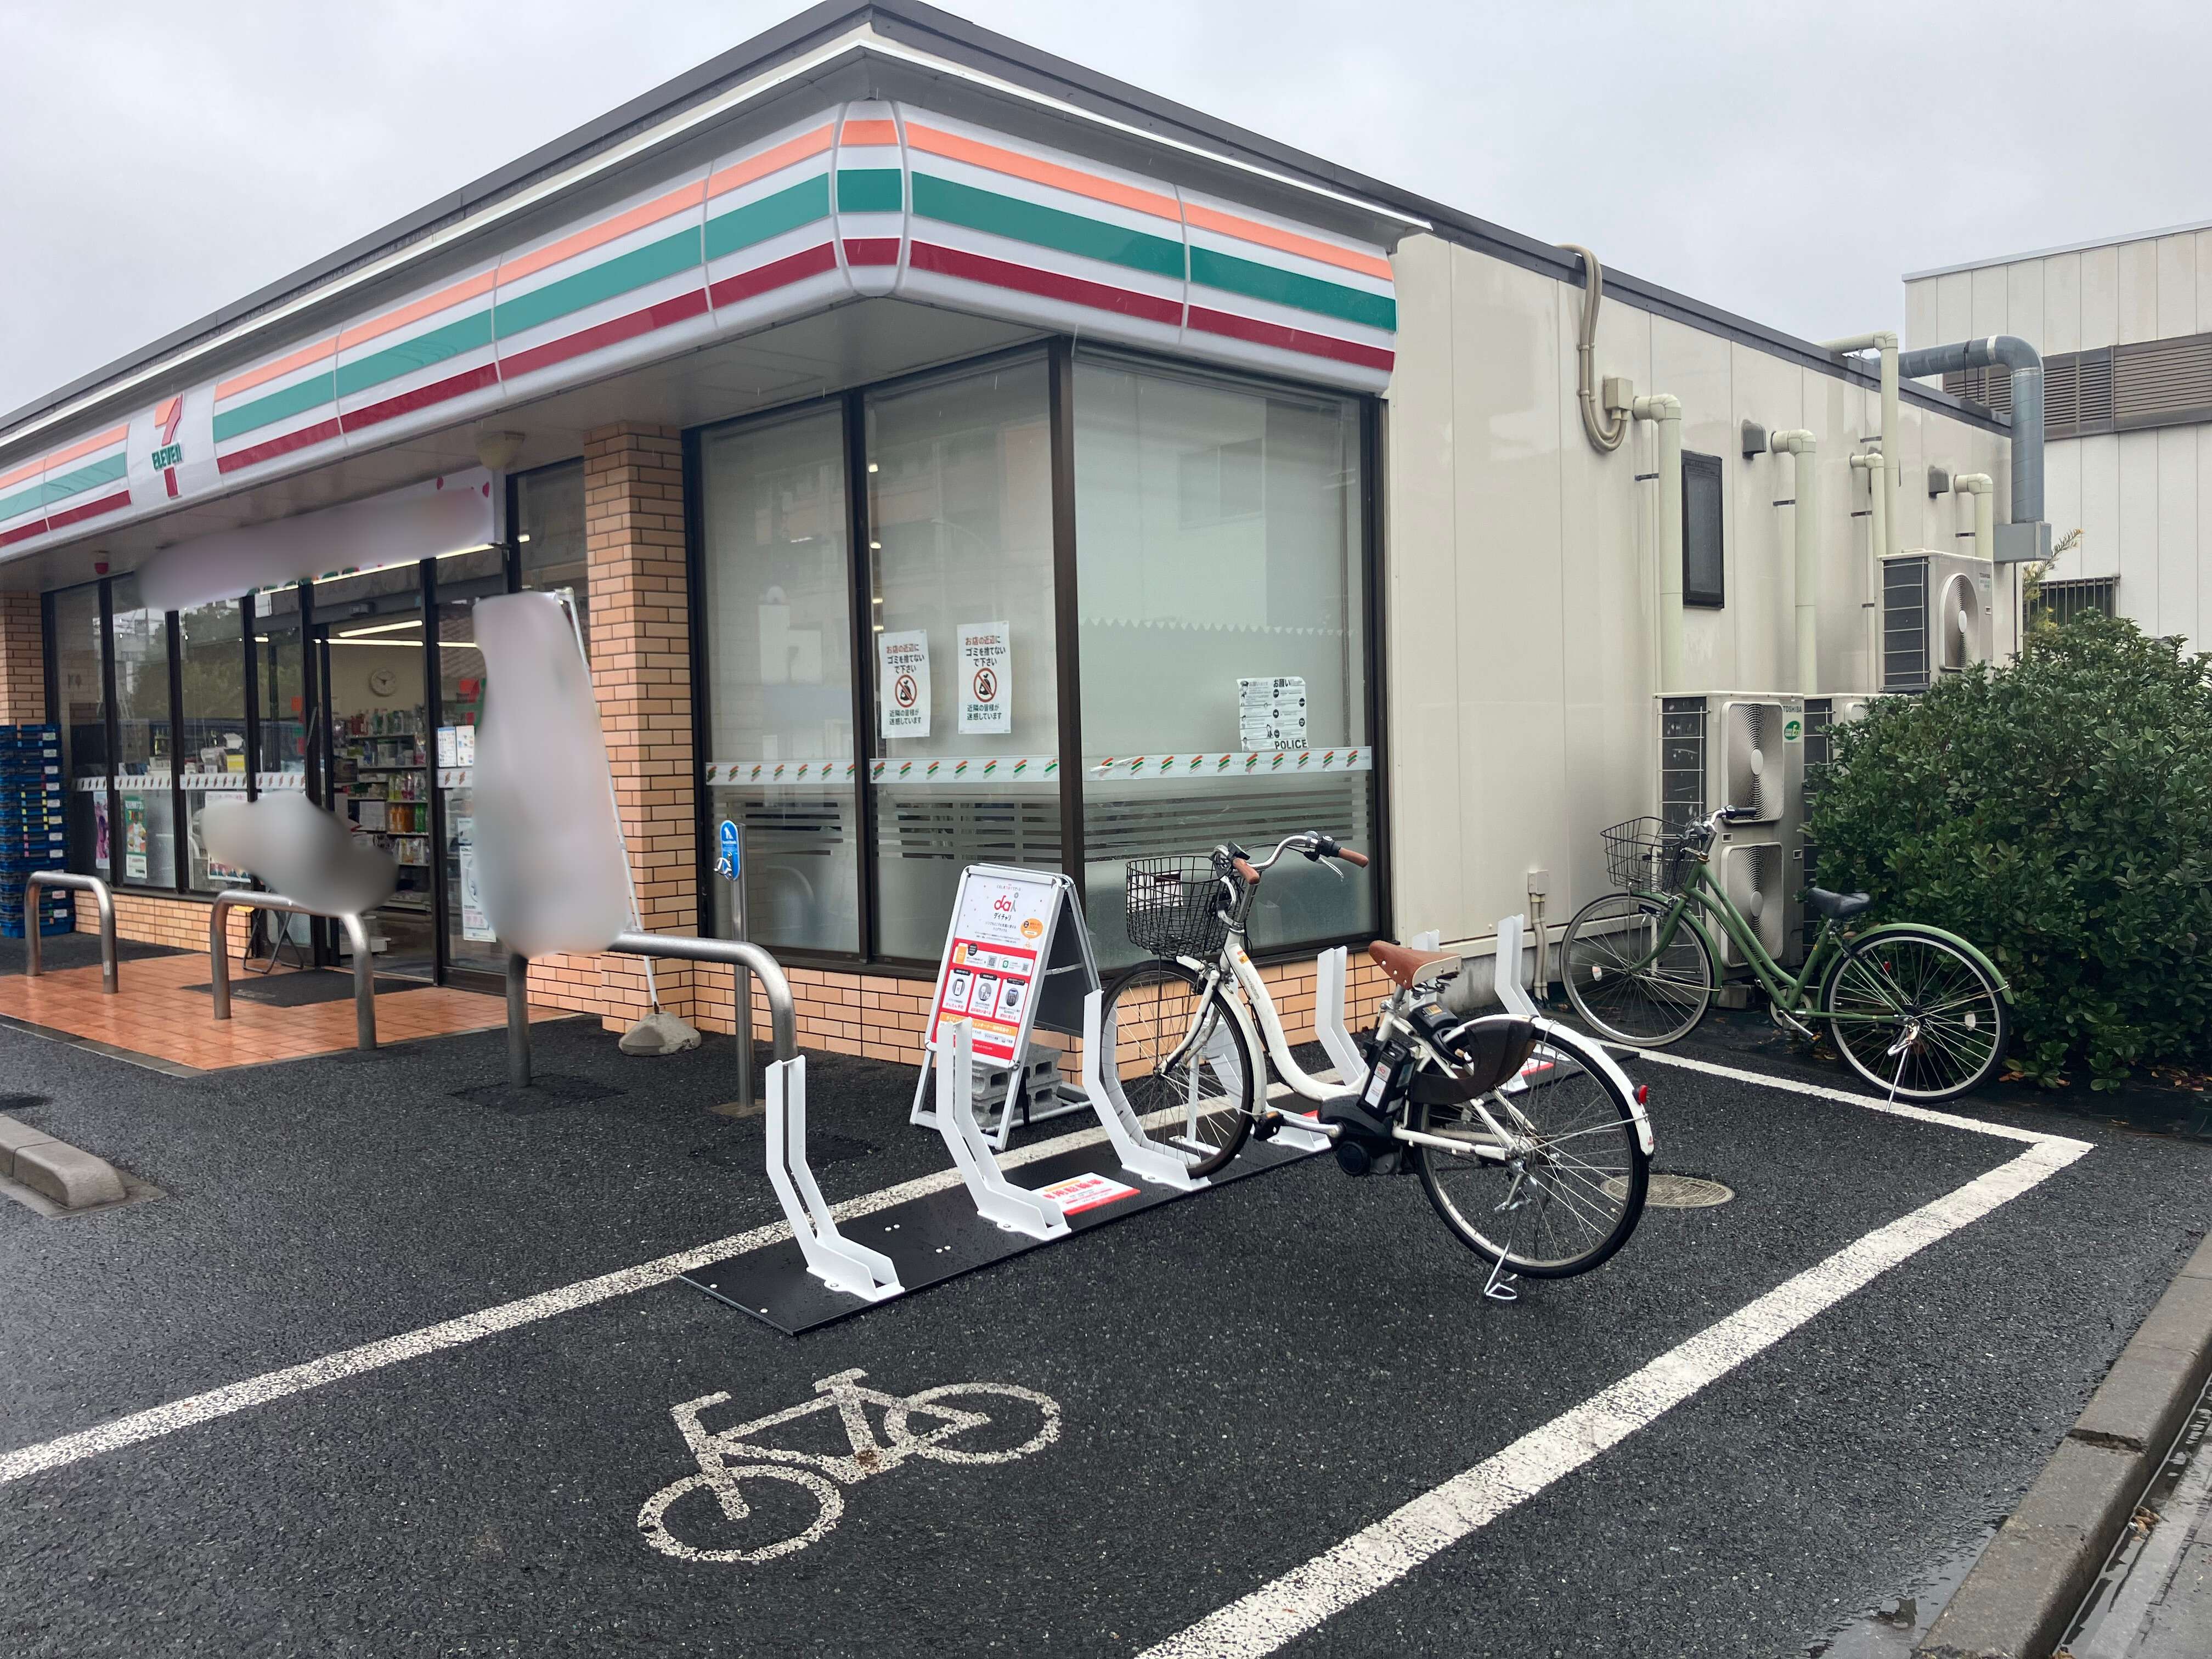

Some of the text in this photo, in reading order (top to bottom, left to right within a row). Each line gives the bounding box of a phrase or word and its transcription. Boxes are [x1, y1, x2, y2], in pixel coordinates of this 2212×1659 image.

[966, 646, 1006, 657] ゴミを捨てない
[973, 657, 997, 667] で下さい
[894, 665, 917, 674] で下さい
[1273, 679, 1291, 688] お願い
[966, 712, 1002, 720] 迷惑しています
[1274, 739, 1307, 750] POLICE
[994, 912, 1012, 921] ダイチャリ
